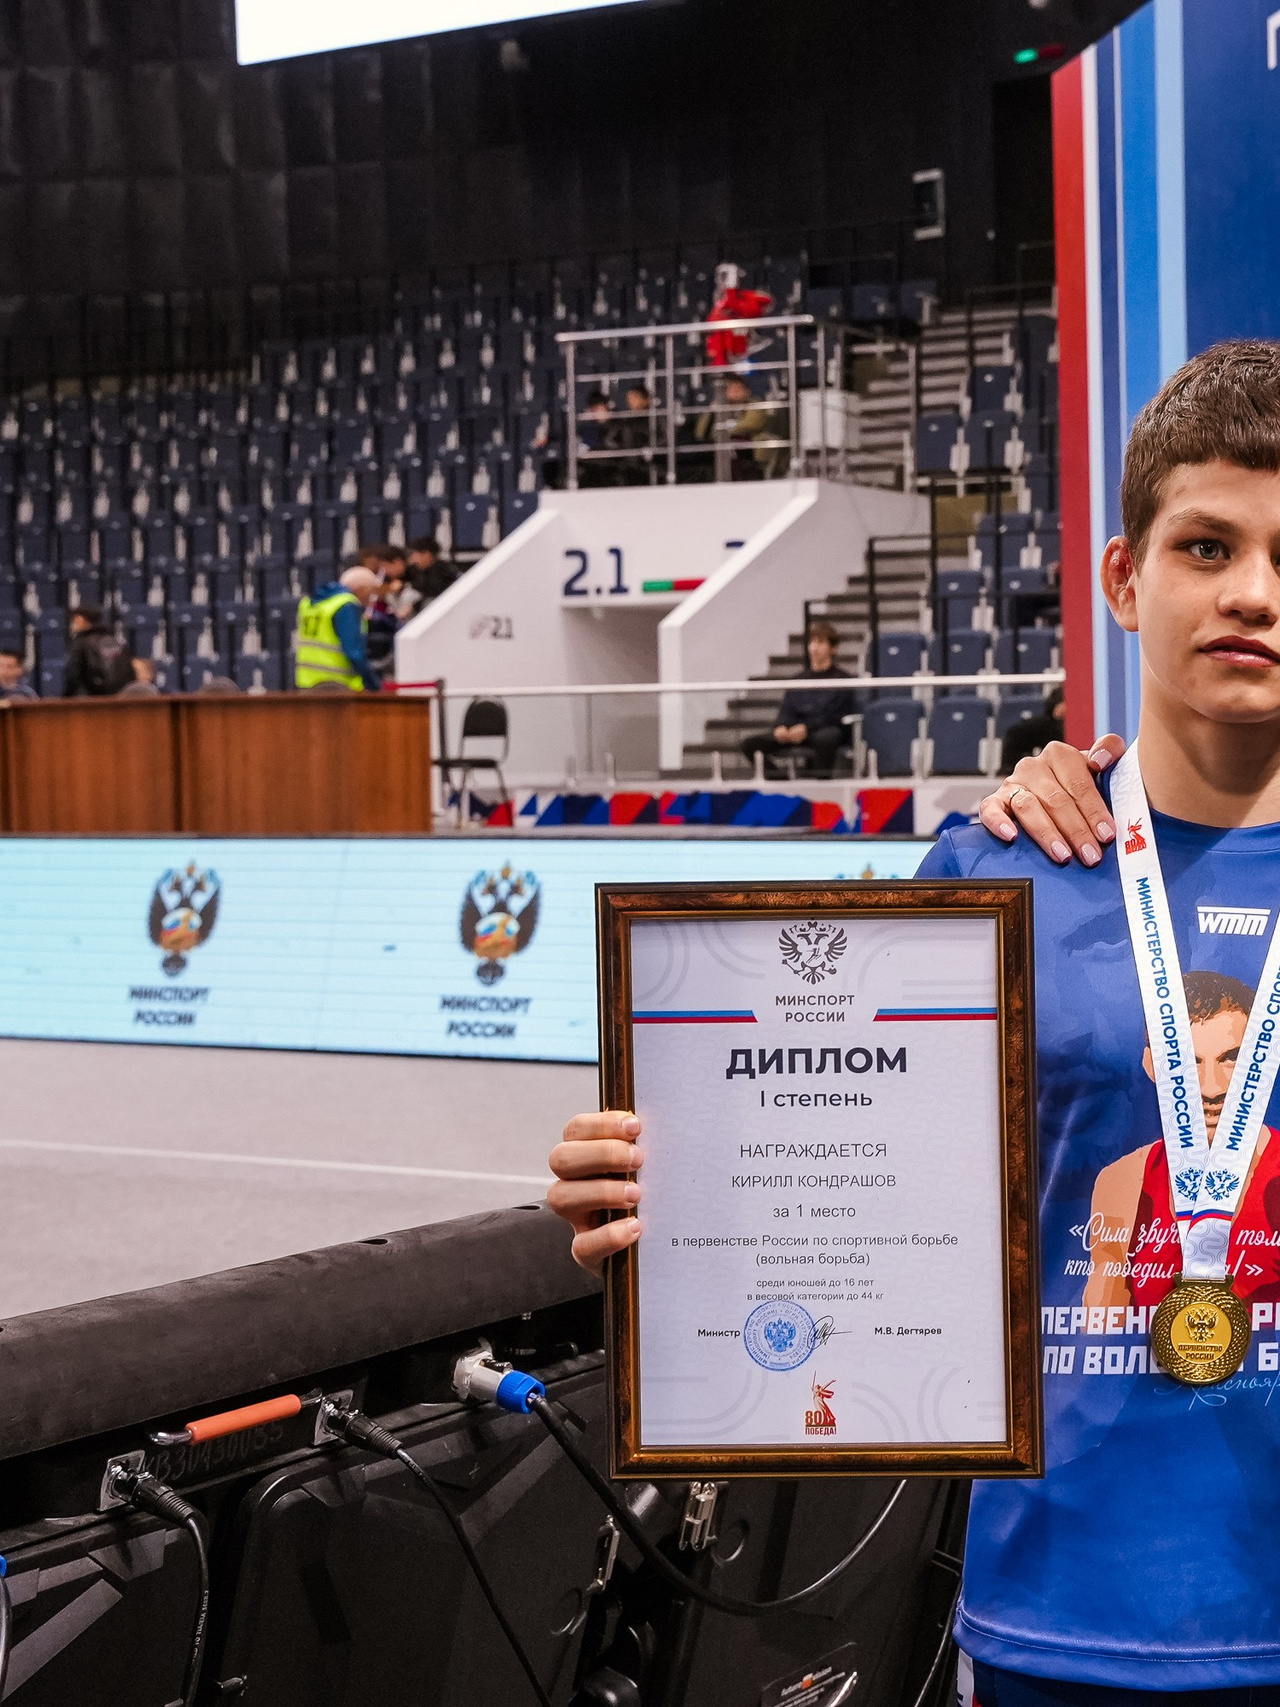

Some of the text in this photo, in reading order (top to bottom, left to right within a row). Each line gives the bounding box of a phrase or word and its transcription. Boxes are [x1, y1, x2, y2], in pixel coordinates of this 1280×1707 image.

[563, 546, 629, 596] 2.1
[1136, 876, 1170, 1000] МИНИСТЕРСТВО
[775, 994, 855, 1007] МИНСПОРТ
[785, 1012, 846, 1022] РОССИИ
[447, 1020, 516, 1038] РОССИИ
[1159, 1002, 1182, 1071] СПОРТА
[725, 1047, 906, 1080] ДИПЛОМ
[1226, 1018, 1276, 1152] МИНИСТЕРСТВО
[773, 1090, 872, 1108] степень
[1170, 1074, 1194, 1149] РОССИИ
[740, 1143, 887, 1160] НАГРАЖДАЕТСЯ
[731, 1174, 896, 1189] КИРИЛЛ КОНДРАШОВ
[773, 1204, 856, 1218] за 1 место
[1068, 1211, 1130, 1252] «Сила
[671, 1232, 958, 1249] в первенстве России по спортивной борьбе
[755, 1252, 871, 1267] (вольная борьба)
[1064, 1258, 1096, 1276] кто
[756, 1277, 874, 1290] среди юношей до 16 лет
[746, 1290, 884, 1303] в весовой категории до 44 кг
[697, 1328, 741, 1340] Министр
[874, 1326, 942, 1337] М.В. Дегтярев
[1178, 1344, 1223, 1352] ПЕРВЕНСТВО
[1185, 1352, 1214, 1360] РОССИИ
[1042, 1346, 1074, 1374] ПО
[805, 1410, 822, 1425] 80
[805, 1426, 837, 1436] ПОБЕДА!
